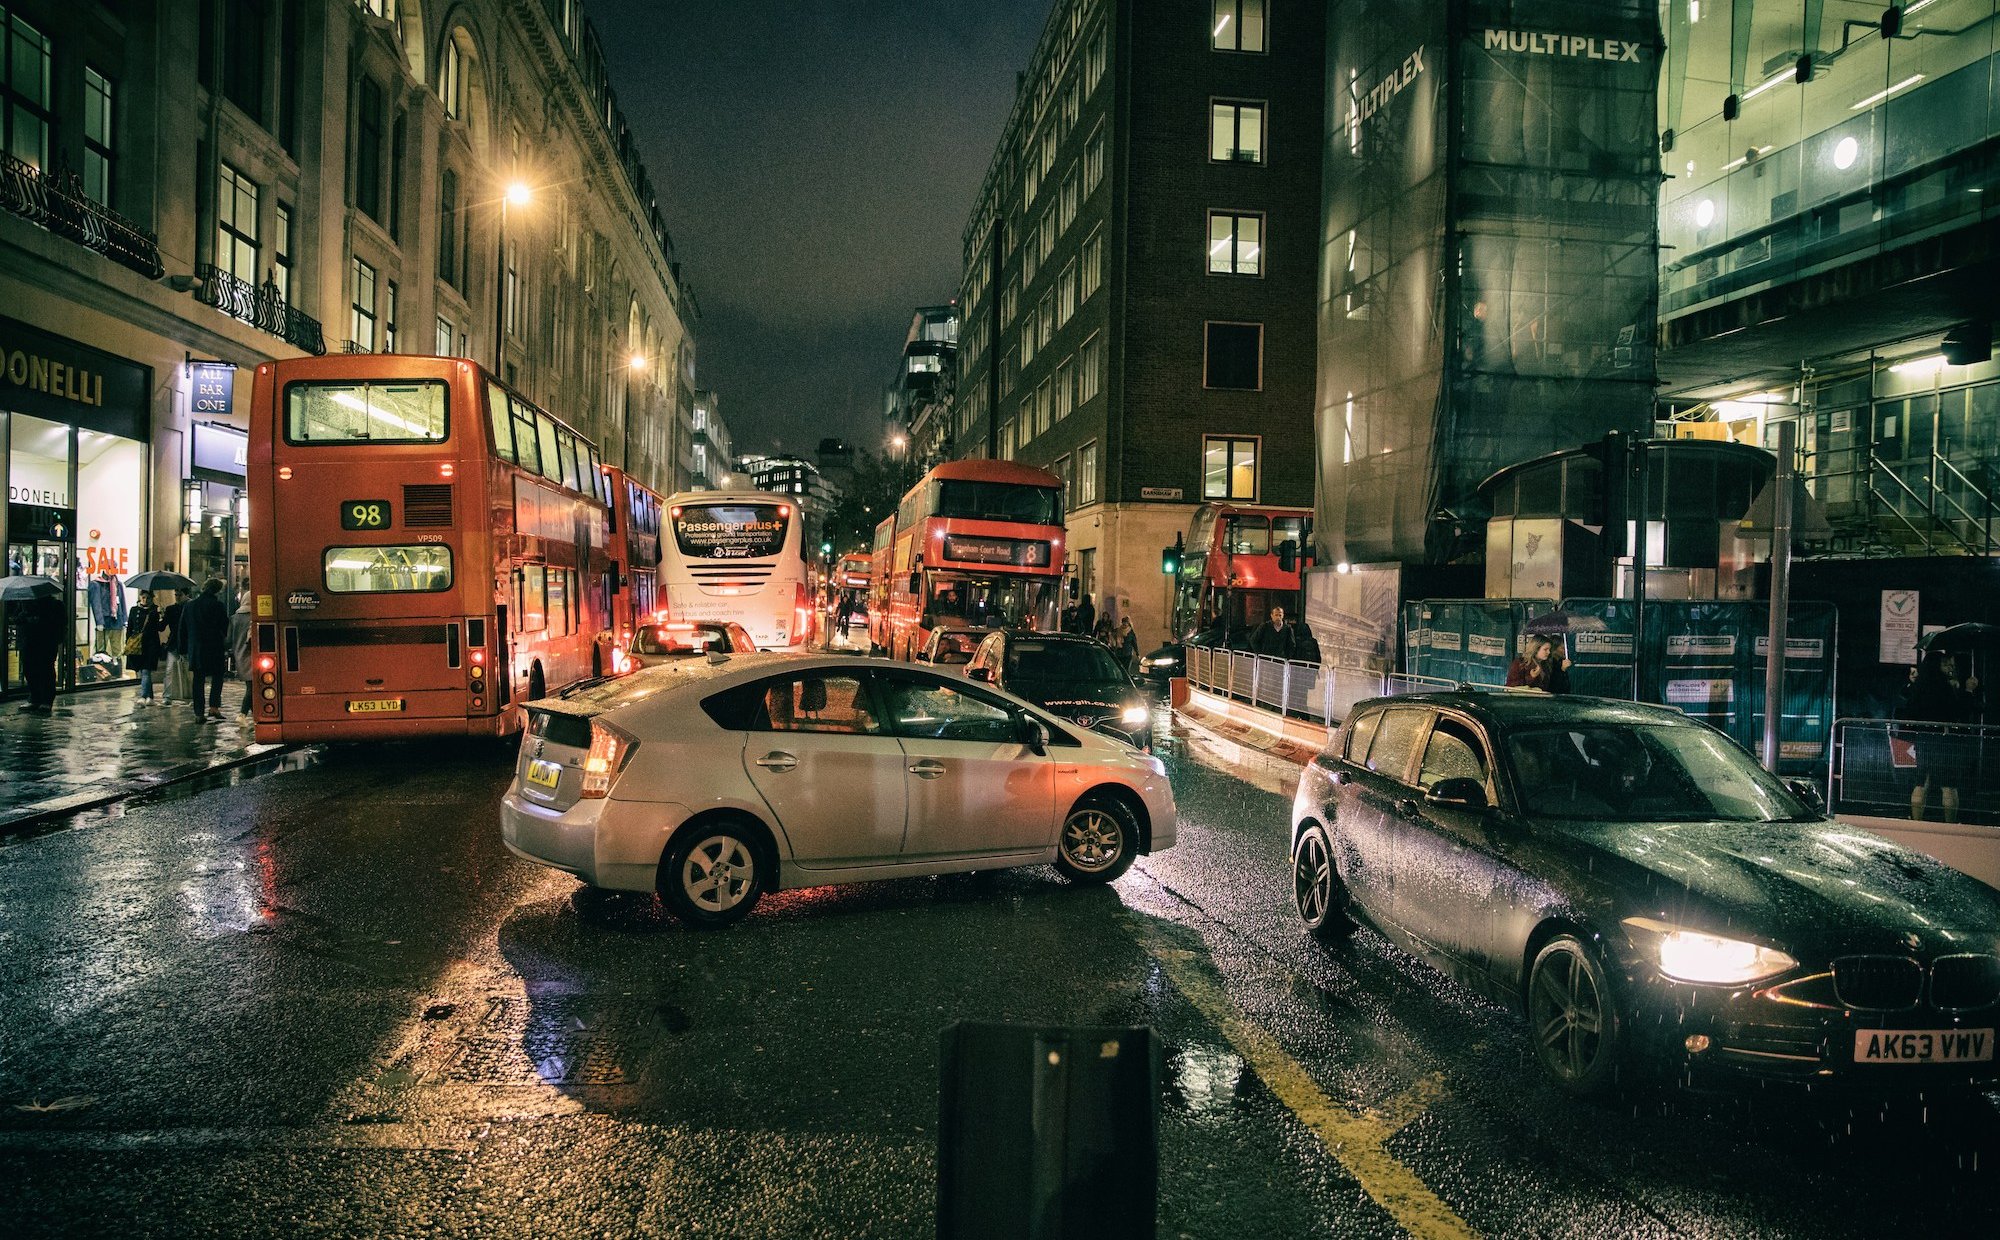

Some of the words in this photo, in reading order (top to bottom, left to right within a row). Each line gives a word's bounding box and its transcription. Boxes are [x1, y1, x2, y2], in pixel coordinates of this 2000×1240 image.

[1484, 28, 1641, 63] MULTIPLEX
[1344, 44, 1425, 137] MULTIPLEX
[0, 346, 103, 407] ONELLI
[200, 368, 224, 380] ALL
[199, 383, 225, 396] BAR
[197, 399, 226, 411] ONE
[352, 504, 382, 527] 98
[417, 534, 443, 543] VP509
[716, 531, 736, 539] ground
[1026, 544, 1036, 561] 8
[86, 546, 128, 575] SALE
[361, 558, 418, 575] Metroline
[1578, 635, 1611, 644] ECHO
[1670, 638, 1697, 646] ECHO
[352, 702, 376, 710] LK53
[380, 701, 398, 710] LYD
[1045, 699, 1121, 709] www.glh.co.uk
[1866, 1034, 1933, 1059] AK63
[1941, 1033, 1985, 1058] VWV
